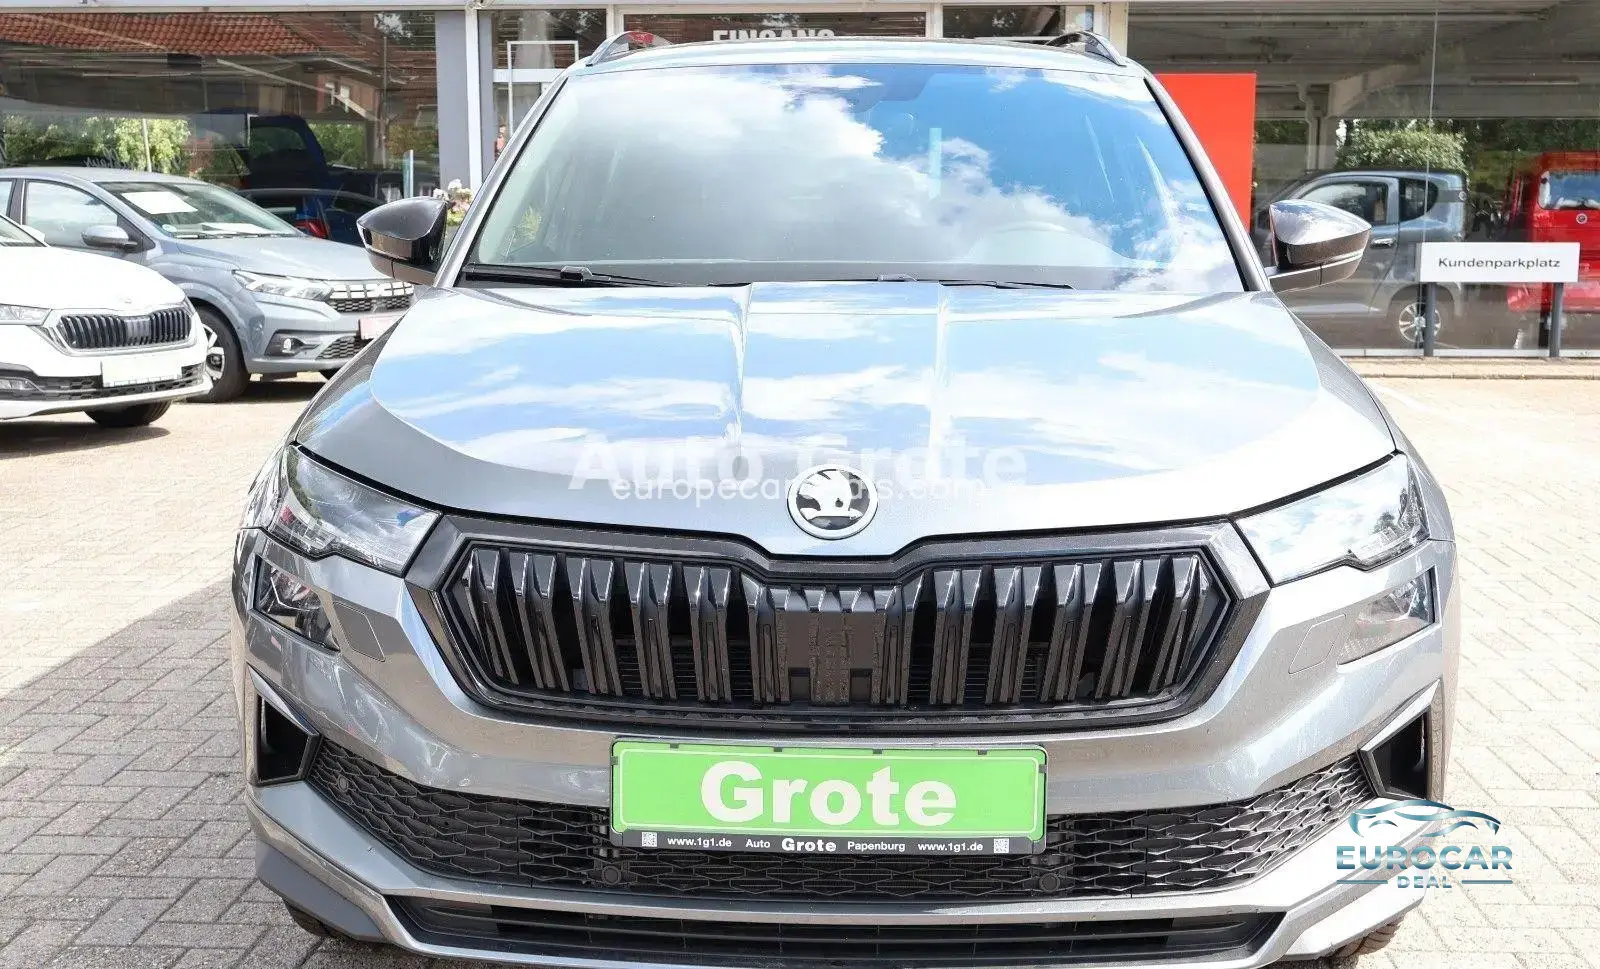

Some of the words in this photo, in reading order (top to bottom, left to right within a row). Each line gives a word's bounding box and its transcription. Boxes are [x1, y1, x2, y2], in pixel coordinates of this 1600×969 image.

[1438, 257, 1561, 270] Kundenparkplatz
[701, 760, 957, 827] Grote
[667, 836, 732, 849] www.1g1.de
[745, 837, 771, 849] Auto
[781, 837, 837, 852] Grote
[847, 840, 906, 852] Papenburg
[917, 841, 984, 852] www.1g1.de
